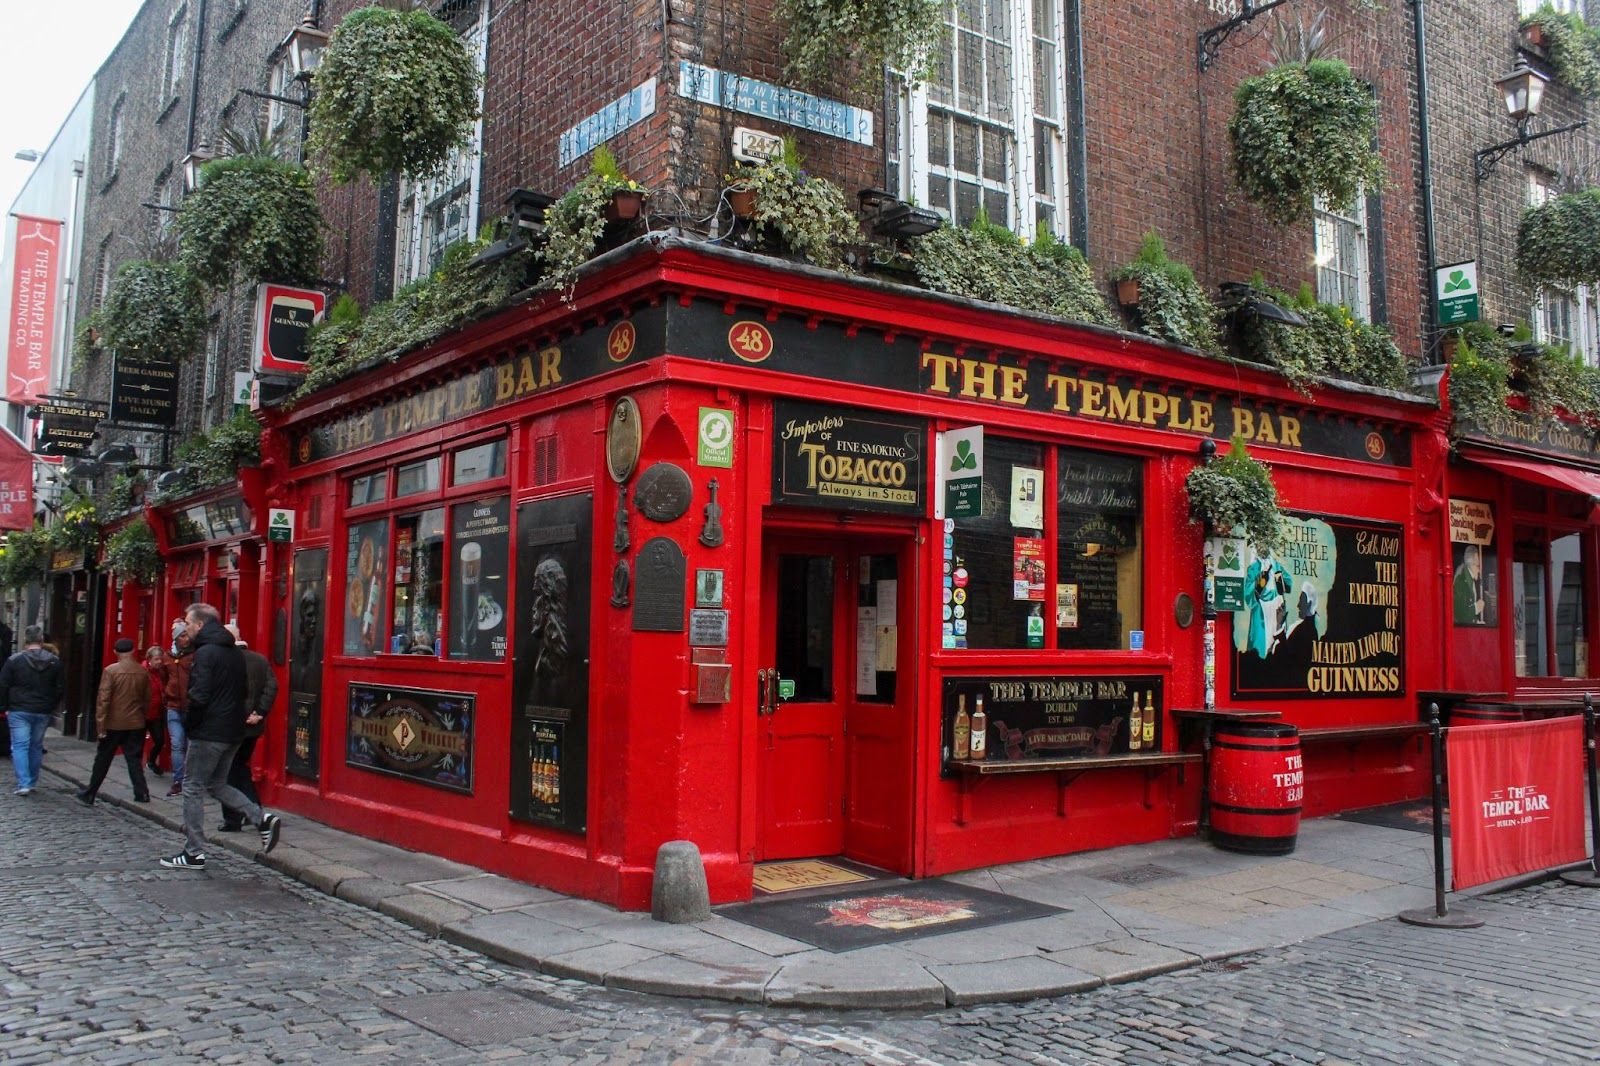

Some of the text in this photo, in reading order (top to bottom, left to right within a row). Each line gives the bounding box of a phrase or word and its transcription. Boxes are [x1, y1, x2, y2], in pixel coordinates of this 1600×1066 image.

[644, 88, 652, 108] 2
[752, 86, 766, 97] AN
[807, 113, 846, 133] SOUTH
[861, 119, 869, 136] 2
[747, 135, 779, 155] 24-7
[16, 268, 31, 348] TRADING CO.
[28, 250, 49, 371] THE TEMPLE BAR
[274, 317, 310, 328] GUINNESS
[612, 329, 631, 354] 48
[737, 326, 763, 353] 48
[118, 366, 175, 378] BEER GARDEN
[118, 396, 171, 407] LIVE MUSIC
[334, 347, 562, 451] THE TEMPLE BAR
[922, 352, 1302, 447] THE TEMPLE BAR
[40, 405, 105, 418] THE TEMPLE BAR
[130, 406, 159, 415] DAILY
[49, 428, 95, 439] DISTILLERY
[781, 416, 844, 443] Importers
[821, 432, 832, 441] OF
[57, 441, 84, 449] STORE
[705, 448, 726, 456] Official
[837, 441, 906, 458] FINE SMOKING
[1368, 433, 1382, 454] 48
[704, 454, 727, 462] Member
[798, 442, 907, 489] TOBACCO
[820, 483, 915, 502] Always in Stock
[1450, 502, 1463, 515] Beer
[1464, 504, 1486, 518] Garden
[1450, 515, 1474, 531] Smoking
[1293, 525, 1318, 543] THE
[1456, 530, 1469, 541] Area
[1282, 544, 1329, 561] TEMPLE
[1380, 537, 1399, 557] 1840
[1293, 559, 1319, 578] BAR
[1375, 561, 1397, 584] THE
[1349, 582, 1399, 607] EMPEROR
[1385, 607, 1398, 630] OF
[1311, 631, 1400, 665] MALTED LIQUORS
[1307, 666, 1399, 692] GUINNESS
[989, 680, 1129, 701] THE TEMPLE BAR
[1045, 702, 1078, 713] DUBLIN
[1029, 733, 1092, 744] LIVE MUSIC DAILY
[1525, 794, 1550, 812] BAR
